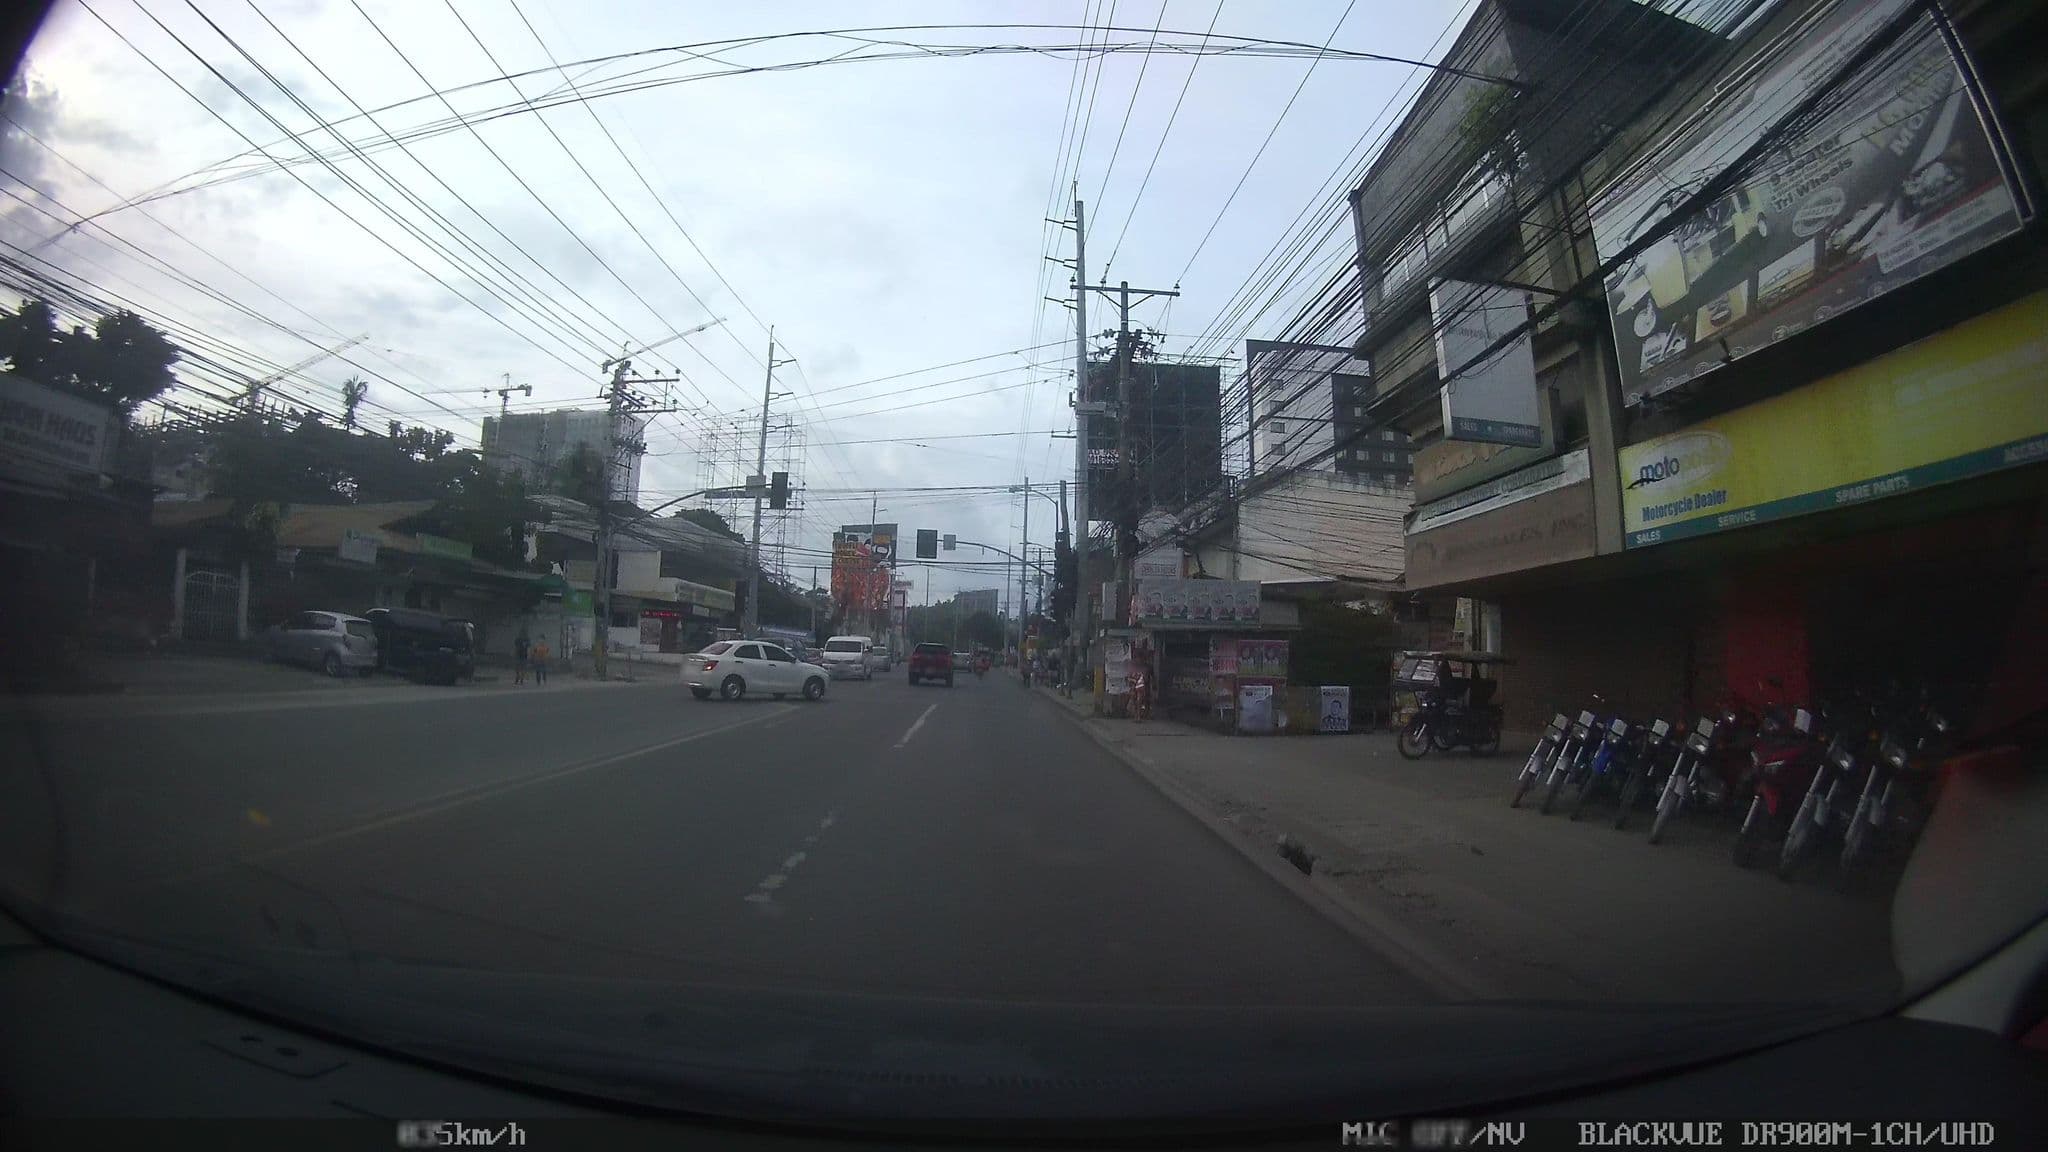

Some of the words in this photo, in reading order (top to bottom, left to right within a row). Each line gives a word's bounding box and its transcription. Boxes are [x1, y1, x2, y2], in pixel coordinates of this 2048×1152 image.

[1796, 157, 1854, 197] Wheels
[1636, 530, 1662, 545] SALES
[1718, 509, 1757, 528] SERVICE
[1835, 483, 1872, 504] SPARE
[1873, 475, 1910, 496] PARTS
[1642, 496, 1694, 522] Motorcycle
[1695, 489, 1728, 510] Dealer
